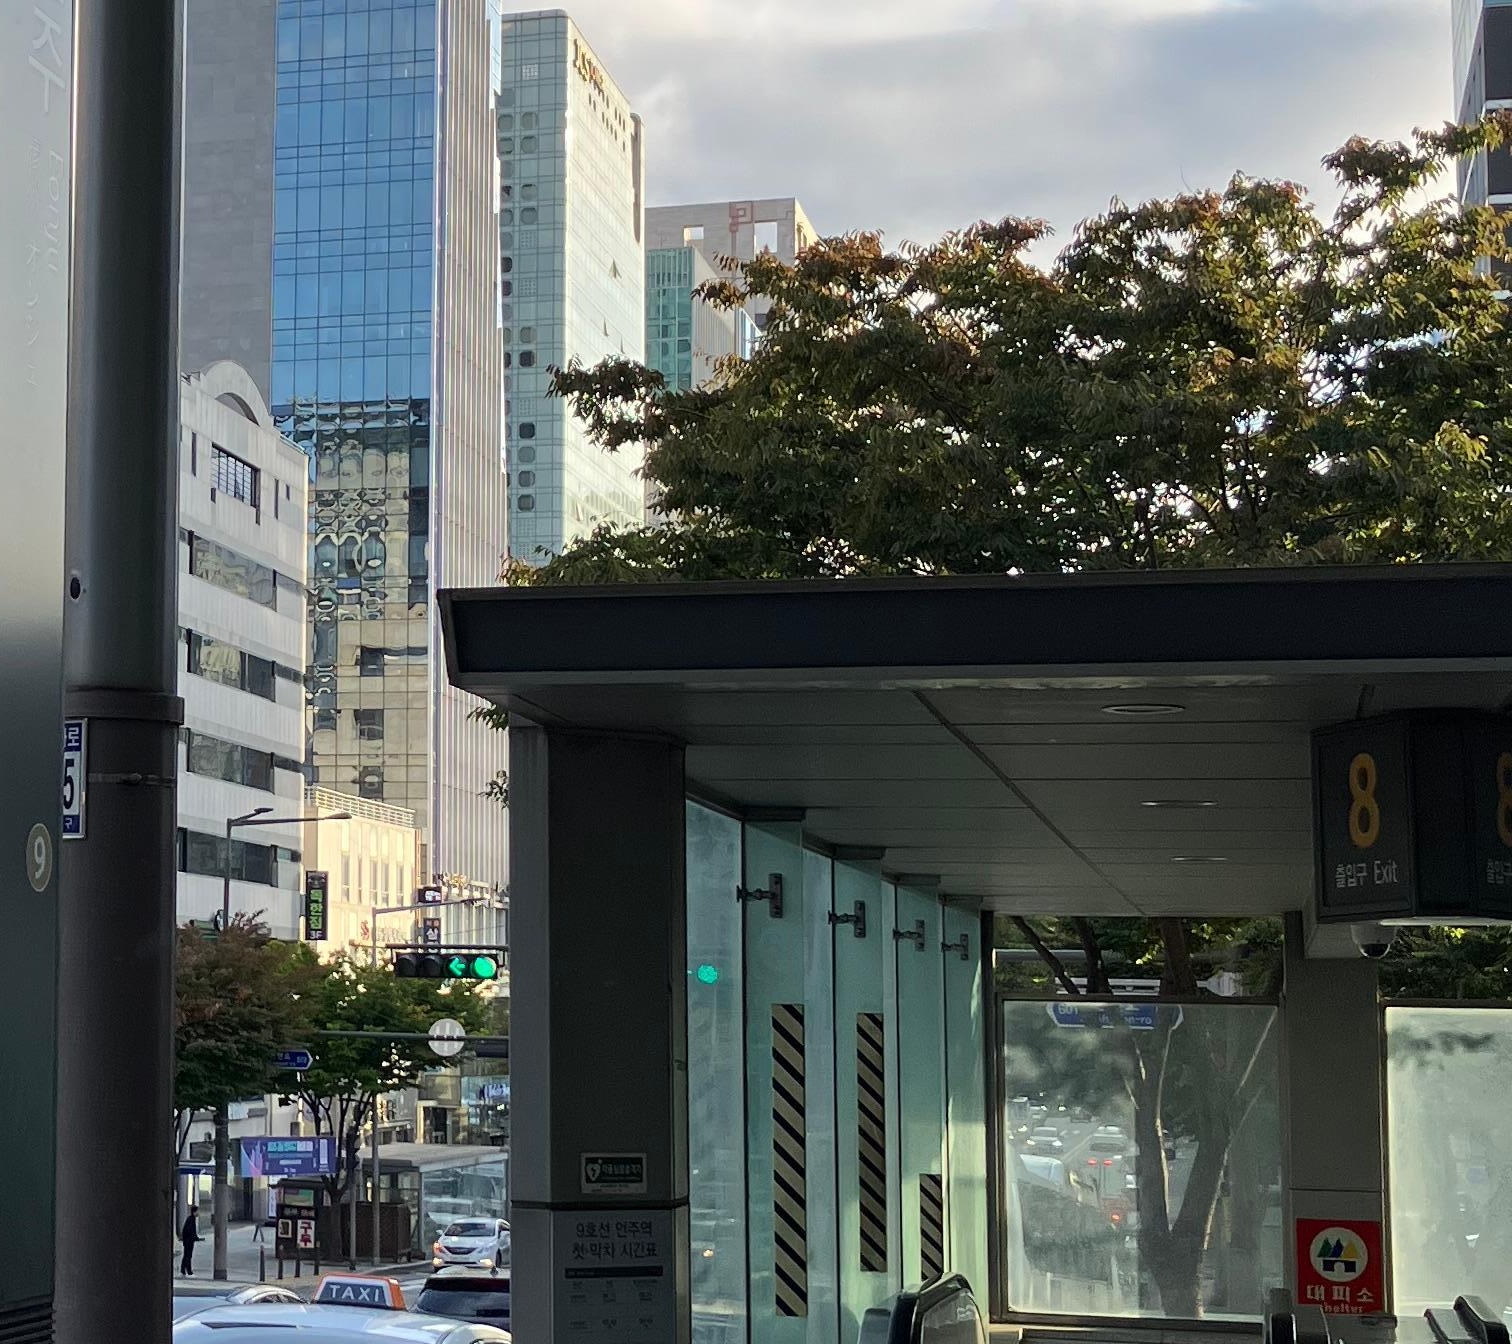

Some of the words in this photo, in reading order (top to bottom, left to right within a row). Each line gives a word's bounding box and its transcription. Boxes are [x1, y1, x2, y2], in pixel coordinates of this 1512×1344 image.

[1348, 751, 1381, 849] 8
[34, 836, 46, 880] 9
[1335, 862, 1371, 890] 출입구
[1373, 859, 1399, 885] Exit
[575, 1220, 610, 1239] 9호선
[615, 1219, 653, 1239] 언주역
[329, 1283, 382, 1303] TAXI
[1305, 1283, 1375, 1304] 대피소
